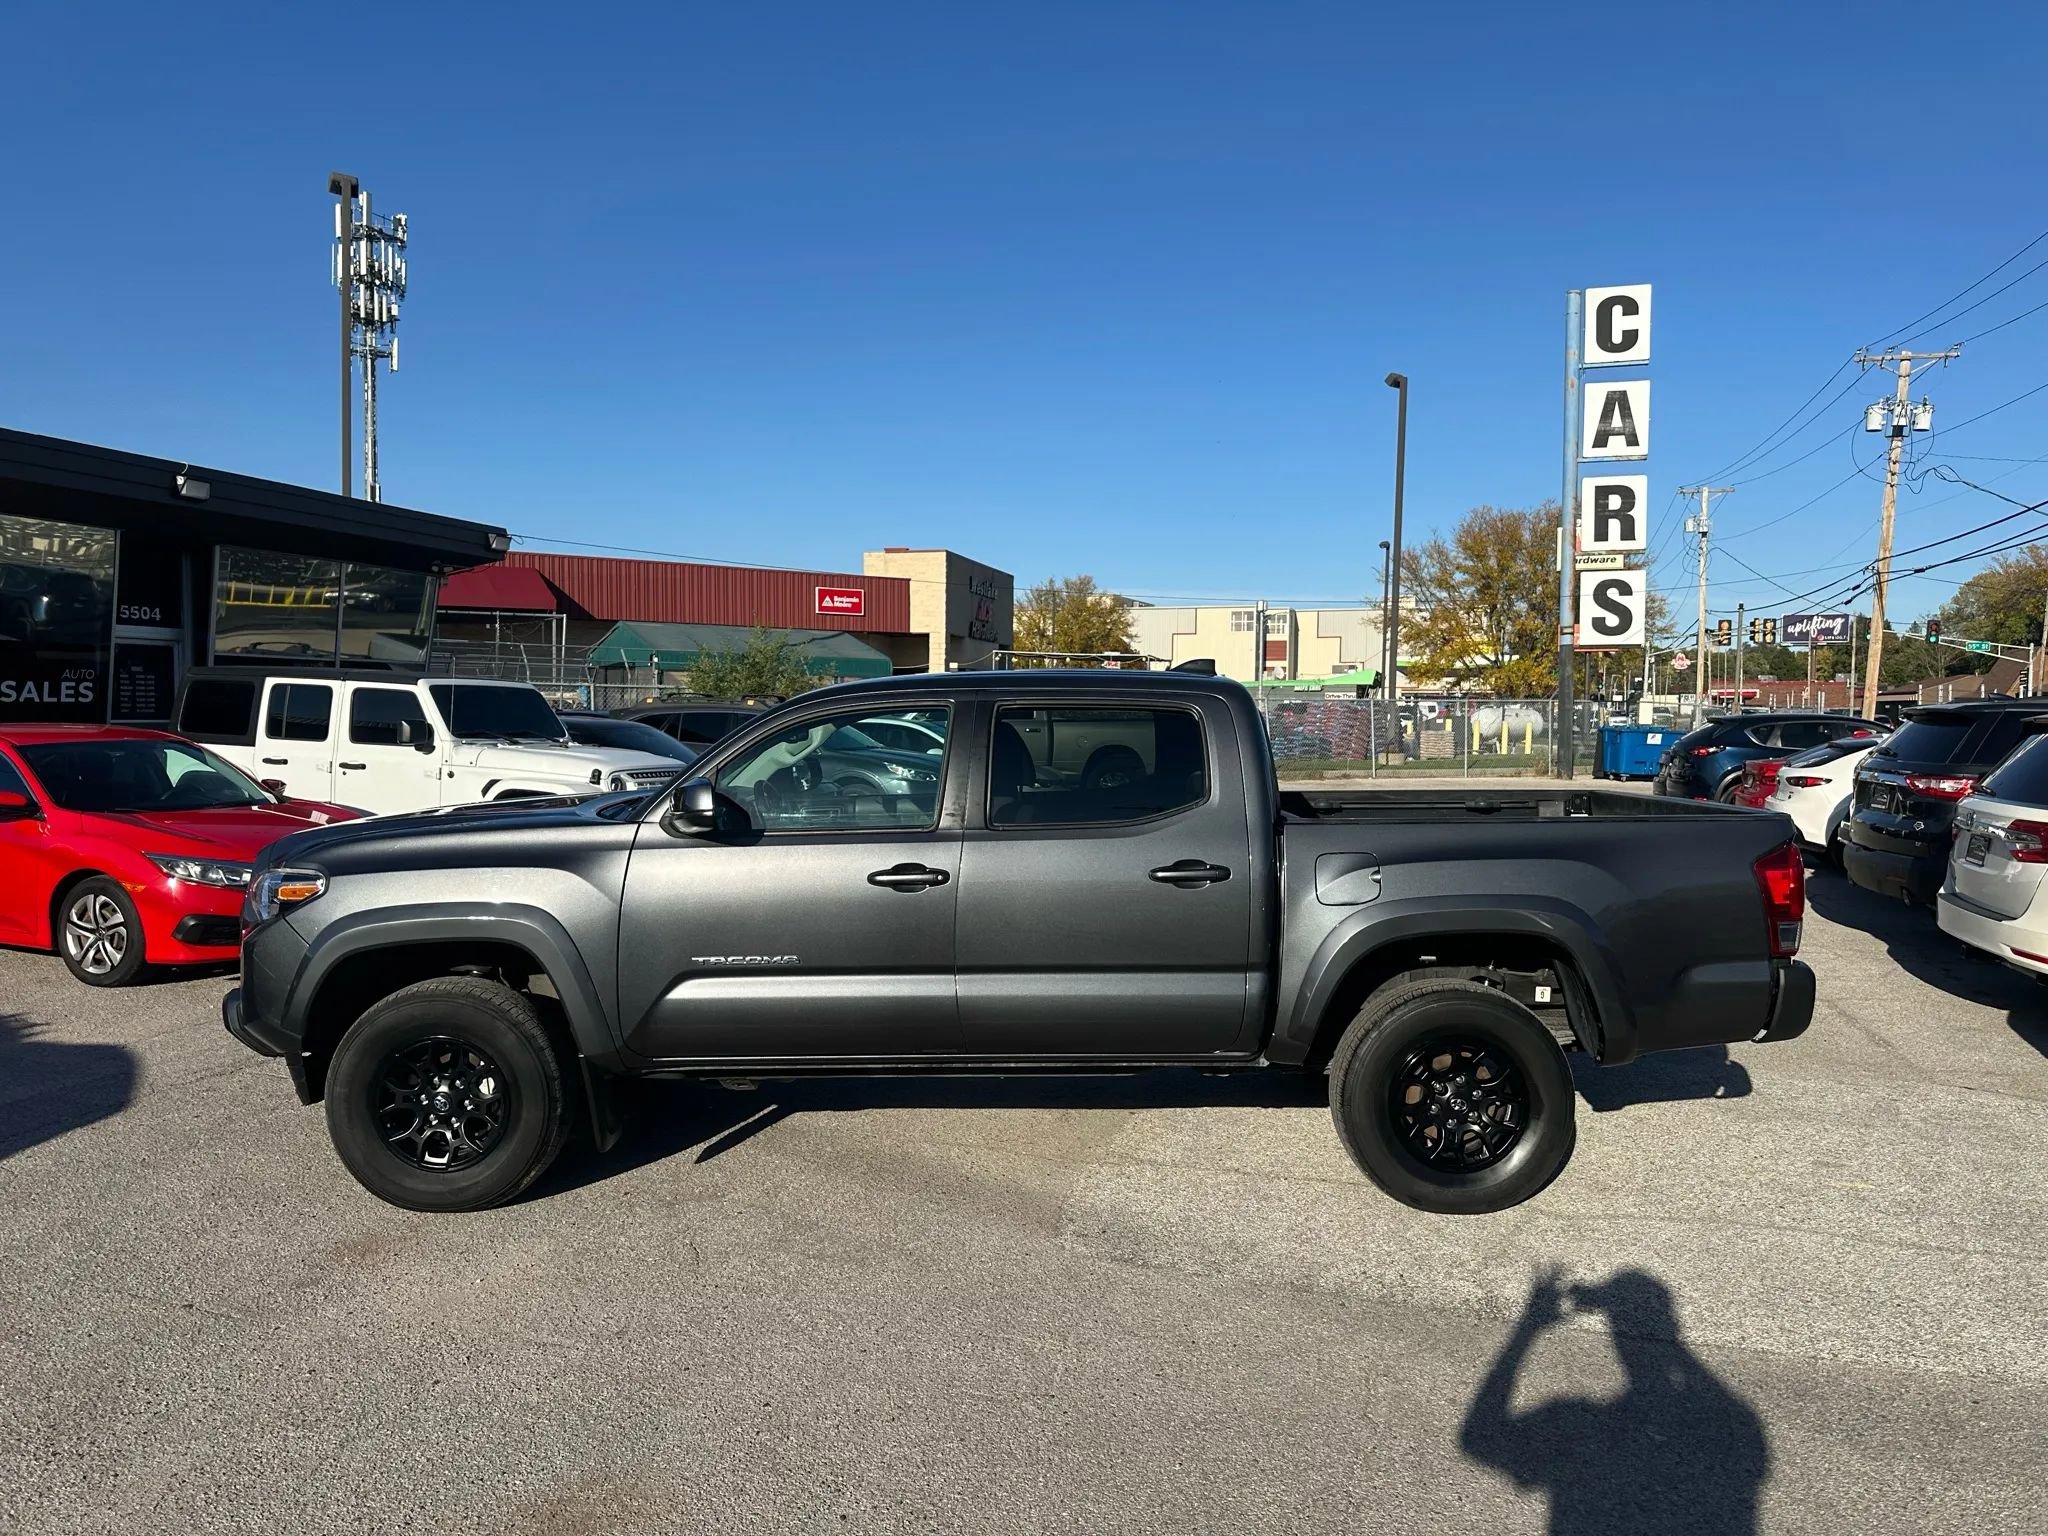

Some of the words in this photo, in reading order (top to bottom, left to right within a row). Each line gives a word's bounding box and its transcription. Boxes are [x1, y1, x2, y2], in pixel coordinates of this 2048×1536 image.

[1592, 294, 1640, 637] CARS
[1575, 556, 1617, 565] rdware
[119, 604, 161, 621] 5504
[1787, 615, 1845, 638] uplifting
[61, 668, 95, 680] AUTO
[0, 680, 94, 703] SALES
[1325, 692, 1356, 700] Drive-Thru
[691, 955, 800, 965] TACOMA
